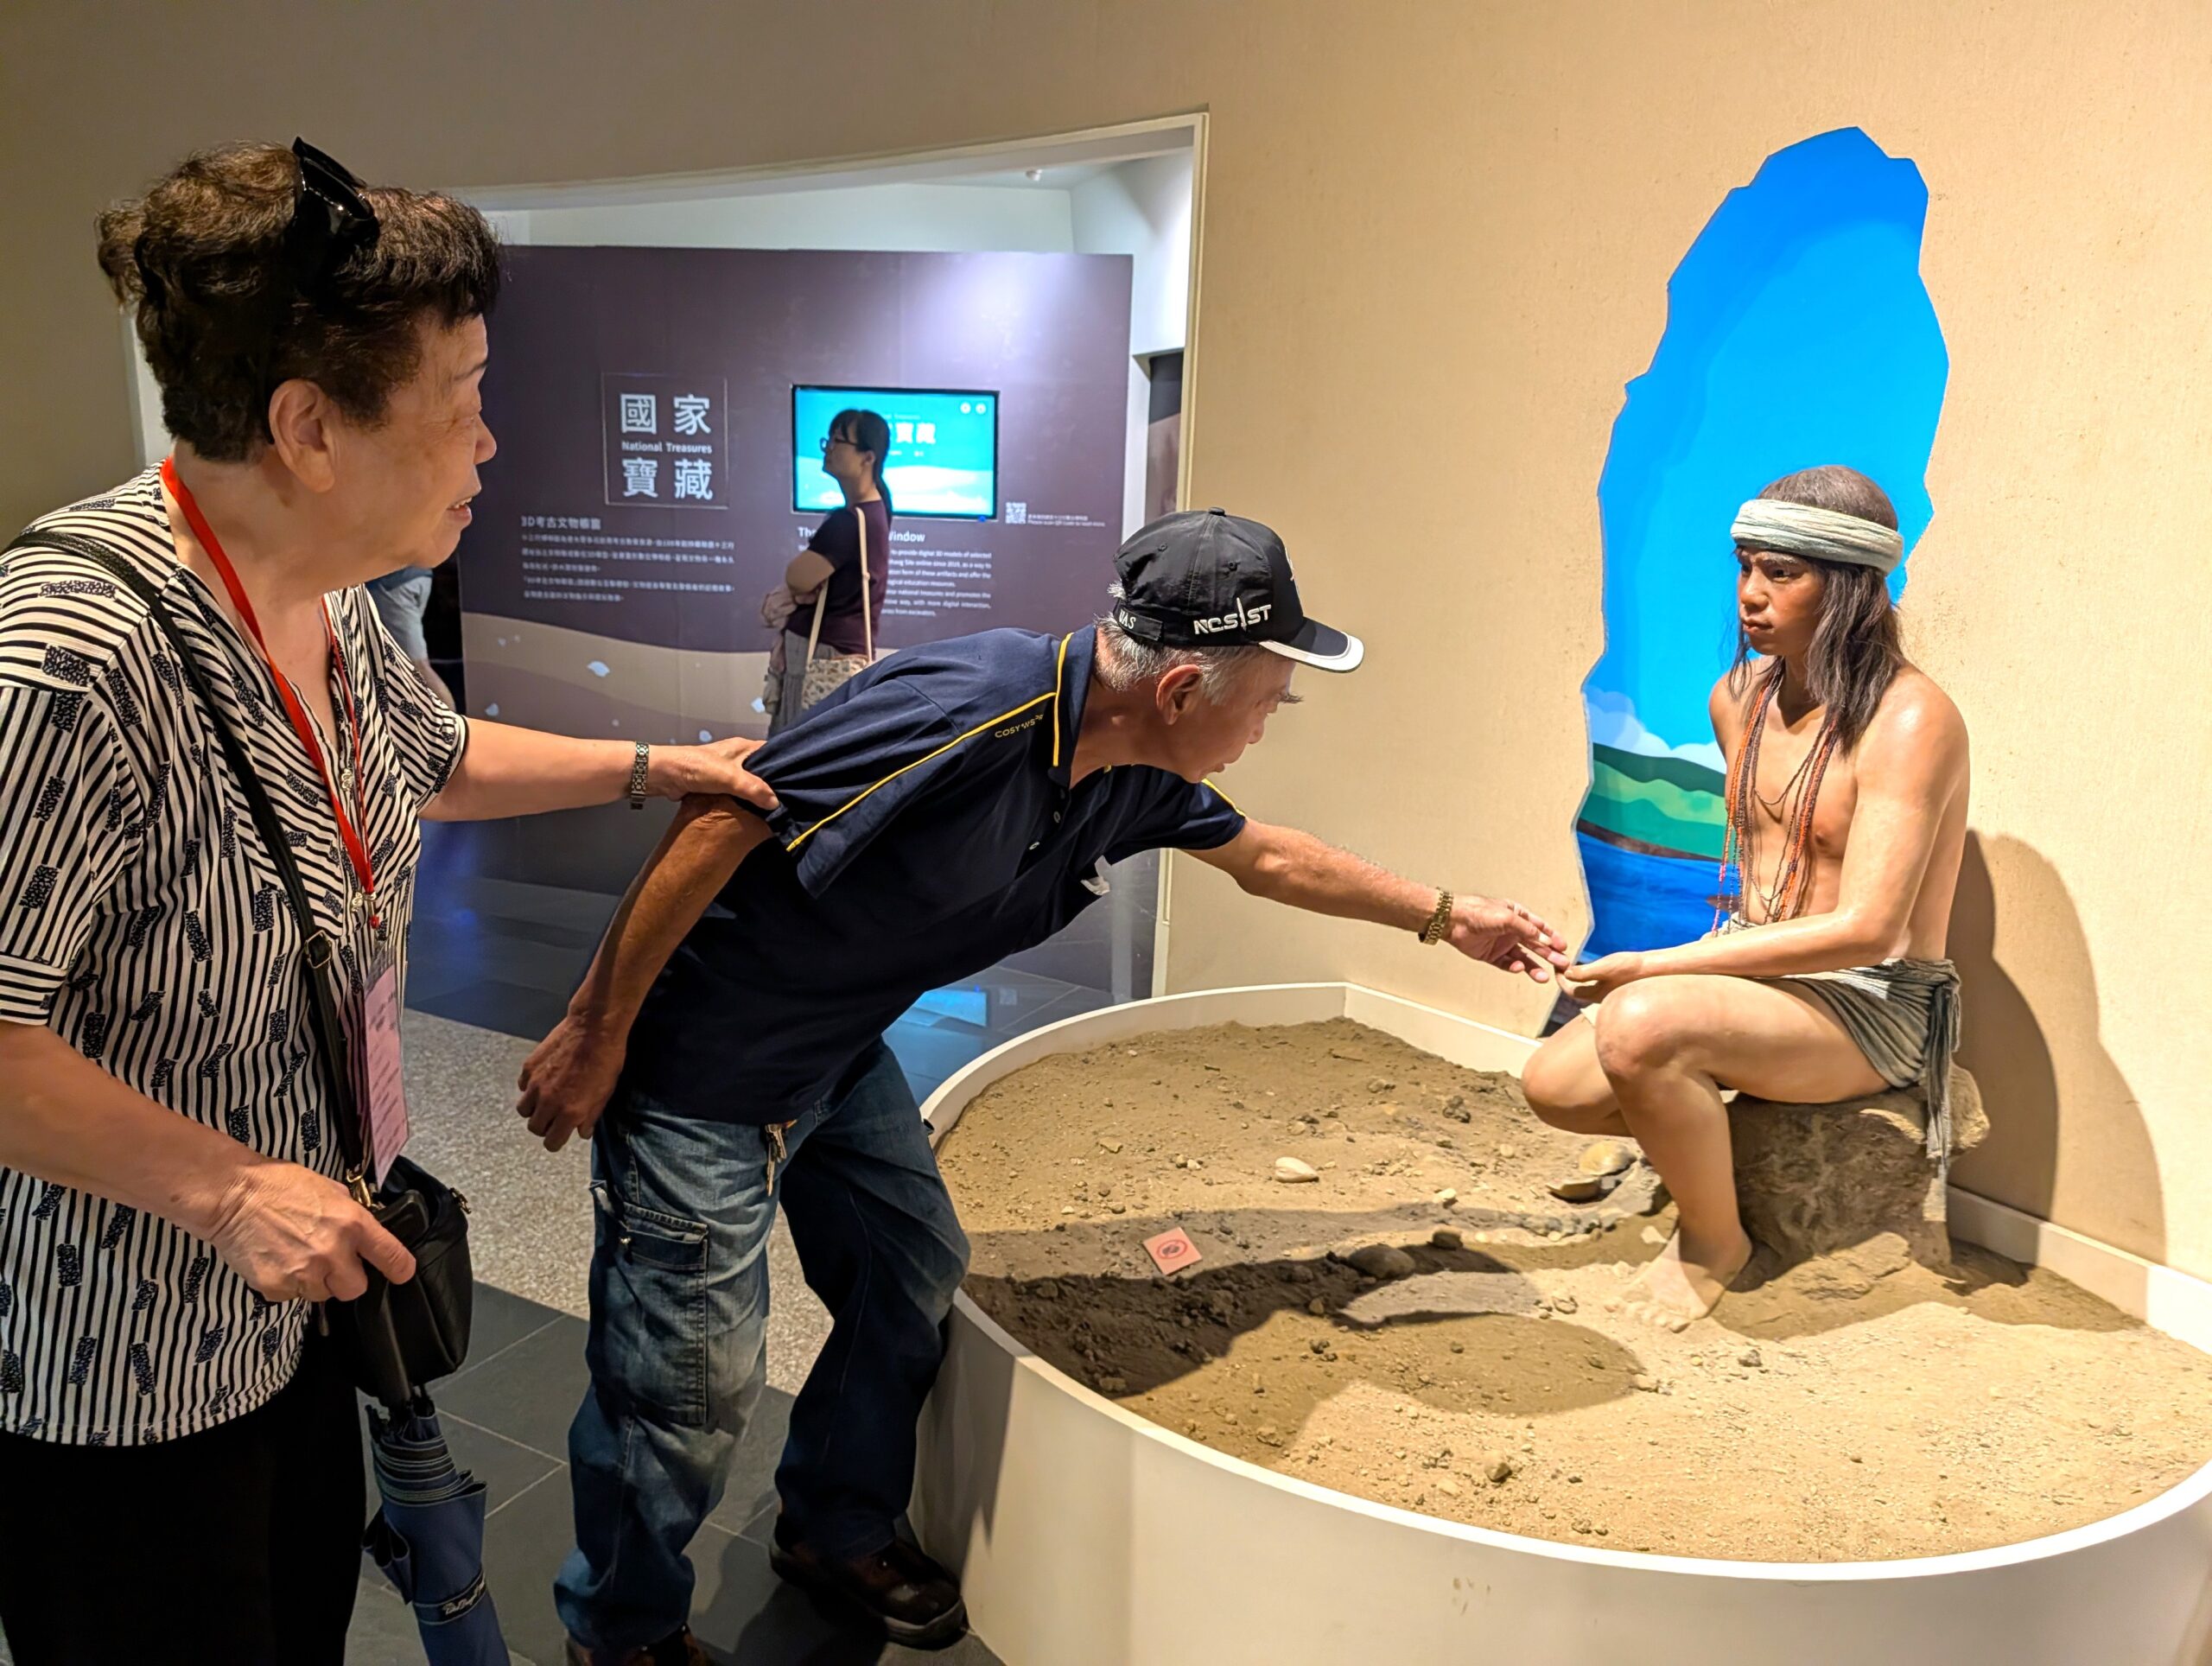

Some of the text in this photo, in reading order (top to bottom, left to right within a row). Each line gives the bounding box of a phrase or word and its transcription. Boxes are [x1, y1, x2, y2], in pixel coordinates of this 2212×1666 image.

[620, 393, 711, 436] 國家
[889, 422, 937, 444] 寶藏
[621, 441, 713, 454] National Treasures
[621, 457, 714, 500] 寶藏
[1119, 608, 1136, 630] UAS
